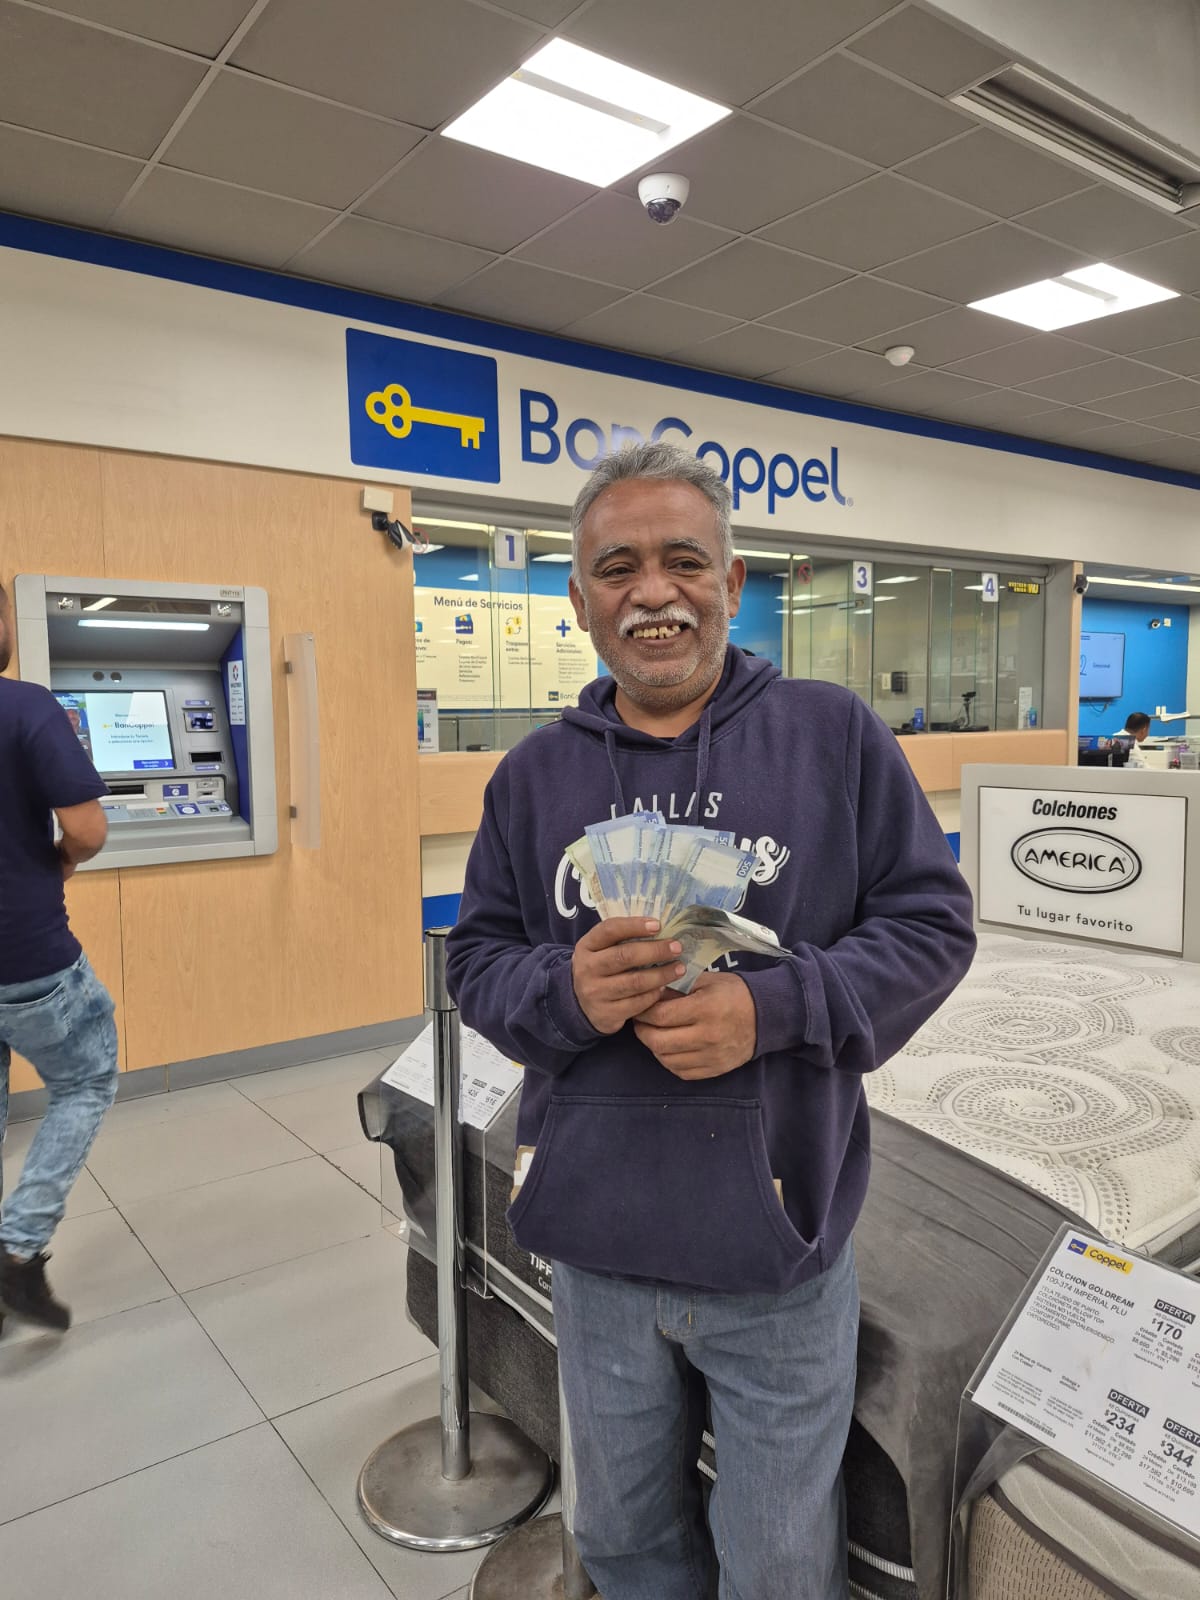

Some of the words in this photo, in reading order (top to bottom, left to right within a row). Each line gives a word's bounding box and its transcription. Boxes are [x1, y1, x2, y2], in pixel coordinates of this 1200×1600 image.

[505, 535, 515, 561] 1
[857, 566, 868, 588] 3
[985, 577, 995, 596] 4
[434, 596, 463, 607] Menú
[465, 598, 478, 608] de
[480, 599, 523, 611] Servicios
[1032, 798, 1118, 821] Colchones
[1024, 848, 1126, 875] AMERICA
[1017, 904, 1032, 917] Tu
[1036, 907, 1071, 923] lugar
[1076, 913, 1134, 932] favorito
[1089, 1249, 1127, 1272] Coppel
[1049, 1266, 1088, 1287] COLCHON
[1088, 1283, 1135, 1309] GOLDREAM
[1073, 1287, 1109, 1309] IMPERIAL
[1110, 1304, 1128, 1317] PLU
[1156, 1301, 1194, 1323] OFERTA
[1152, 1318, 1183, 1340] $170
[1110, 1391, 1147, 1417] OFERTA
[1104, 1409, 1136, 1435] $234
[1160, 1440, 1195, 1468] $344
[1172, 1464, 1196, 1480] Contado
